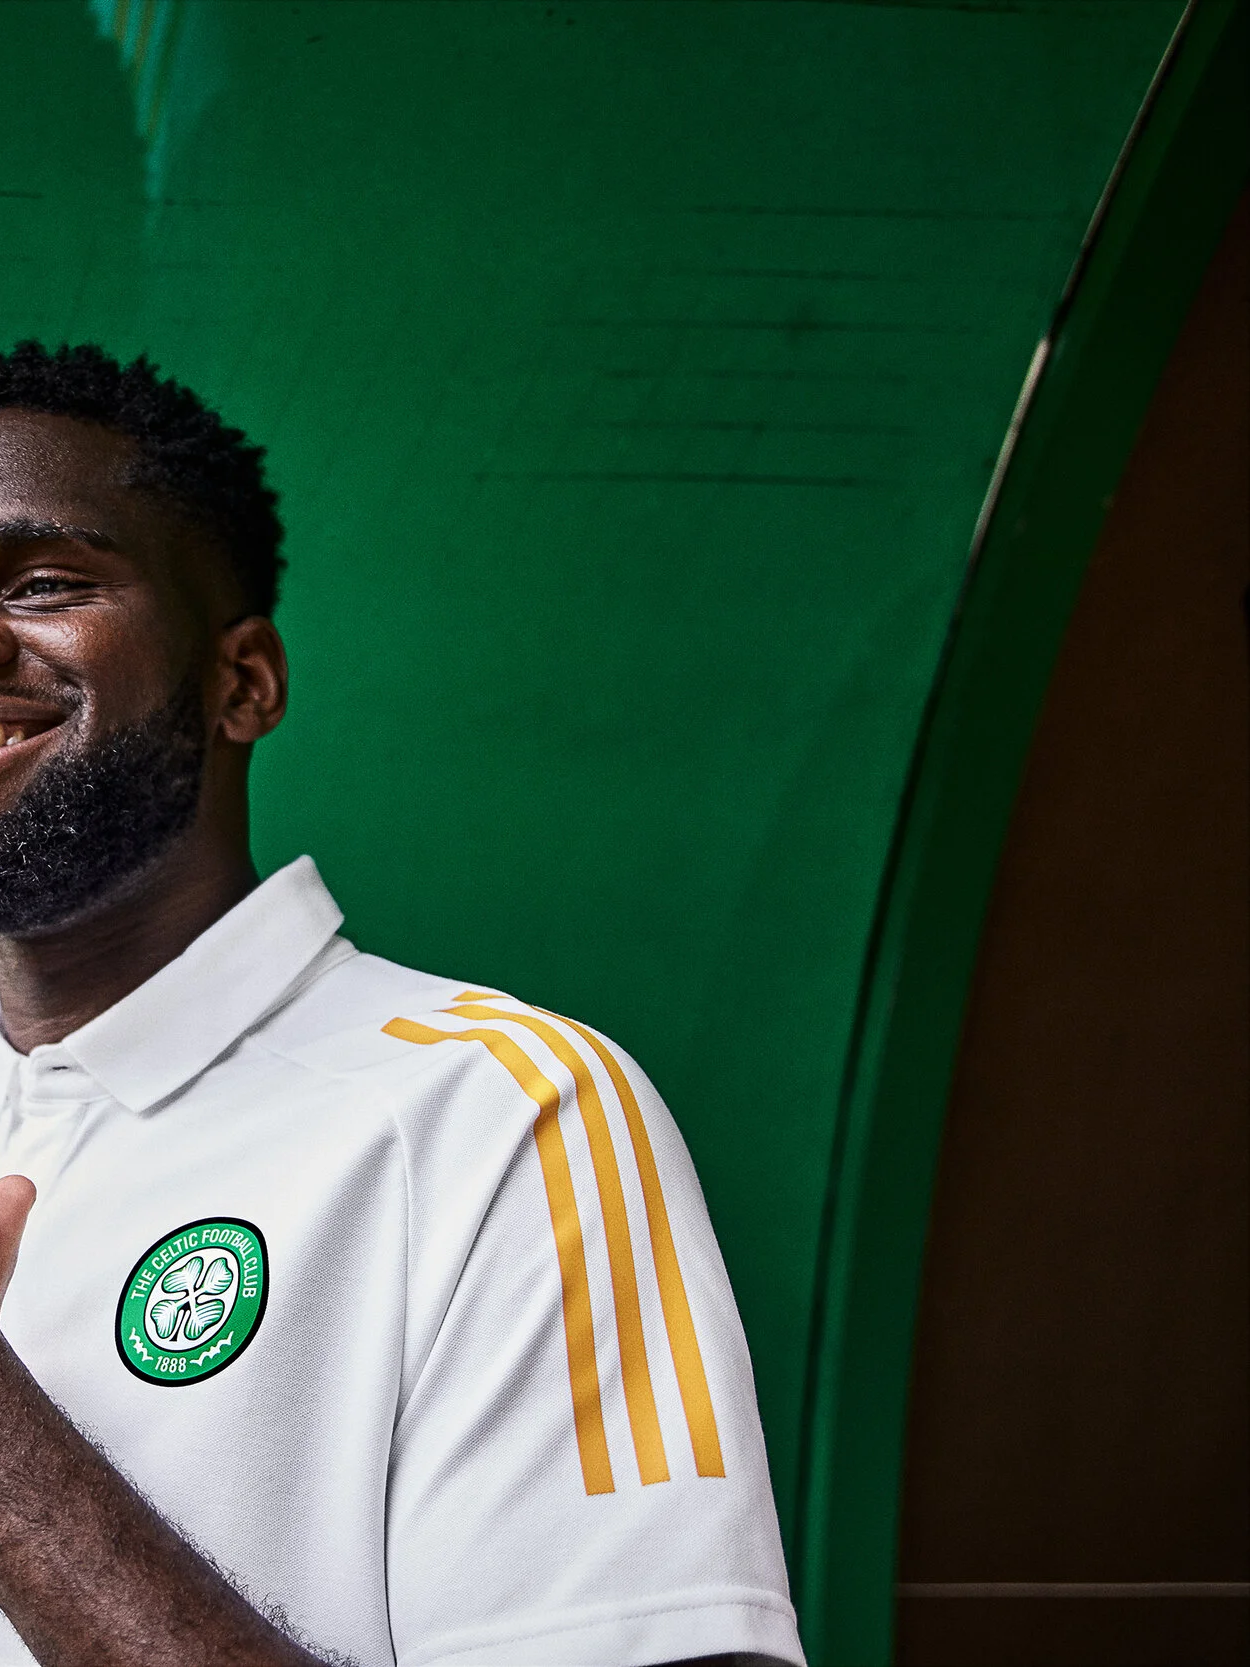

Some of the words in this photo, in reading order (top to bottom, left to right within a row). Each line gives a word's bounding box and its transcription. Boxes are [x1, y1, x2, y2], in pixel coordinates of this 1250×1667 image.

[131, 1271, 156, 1300] THE
[152, 1232, 199, 1270] CELTIC
[201, 1228, 255, 1260] FOOTBALL
[242, 1256, 258, 1298] CLUB
[155, 1355, 187, 1373] 1888
